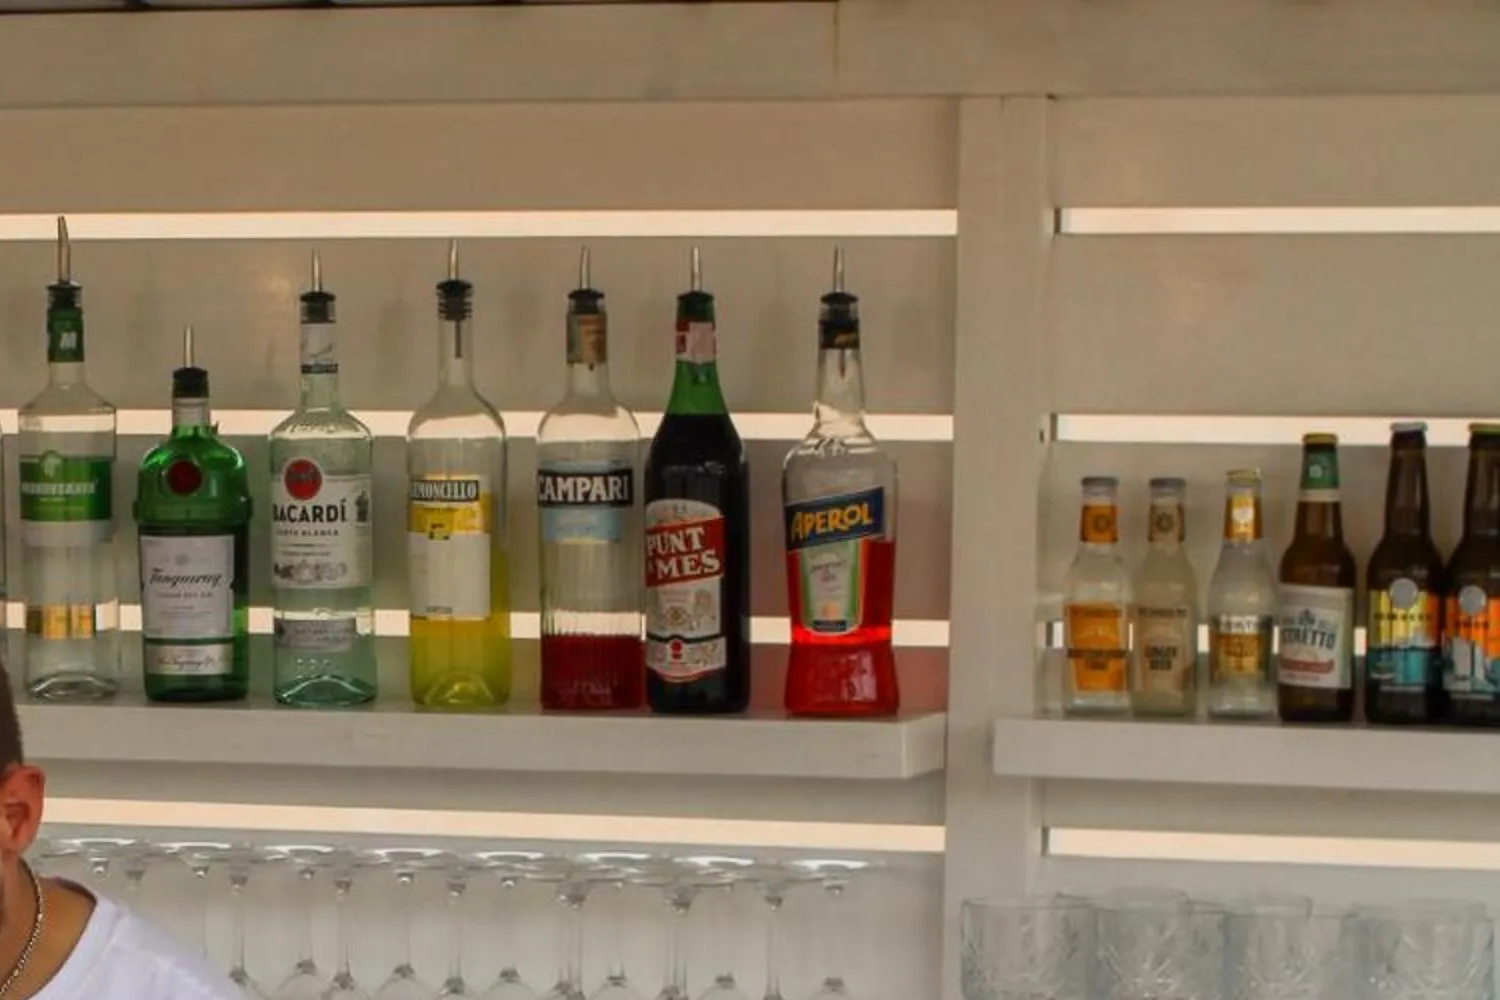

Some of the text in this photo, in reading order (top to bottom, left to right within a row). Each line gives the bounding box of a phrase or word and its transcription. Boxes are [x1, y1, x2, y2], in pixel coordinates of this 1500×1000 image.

[539, 475, 629, 502] CAMPARI
[272, 498, 347, 523] BACARDÍ
[791, 501, 874, 541] APEROL
[646, 527, 705, 557] PUNT
[655, 548, 721, 580] MES
